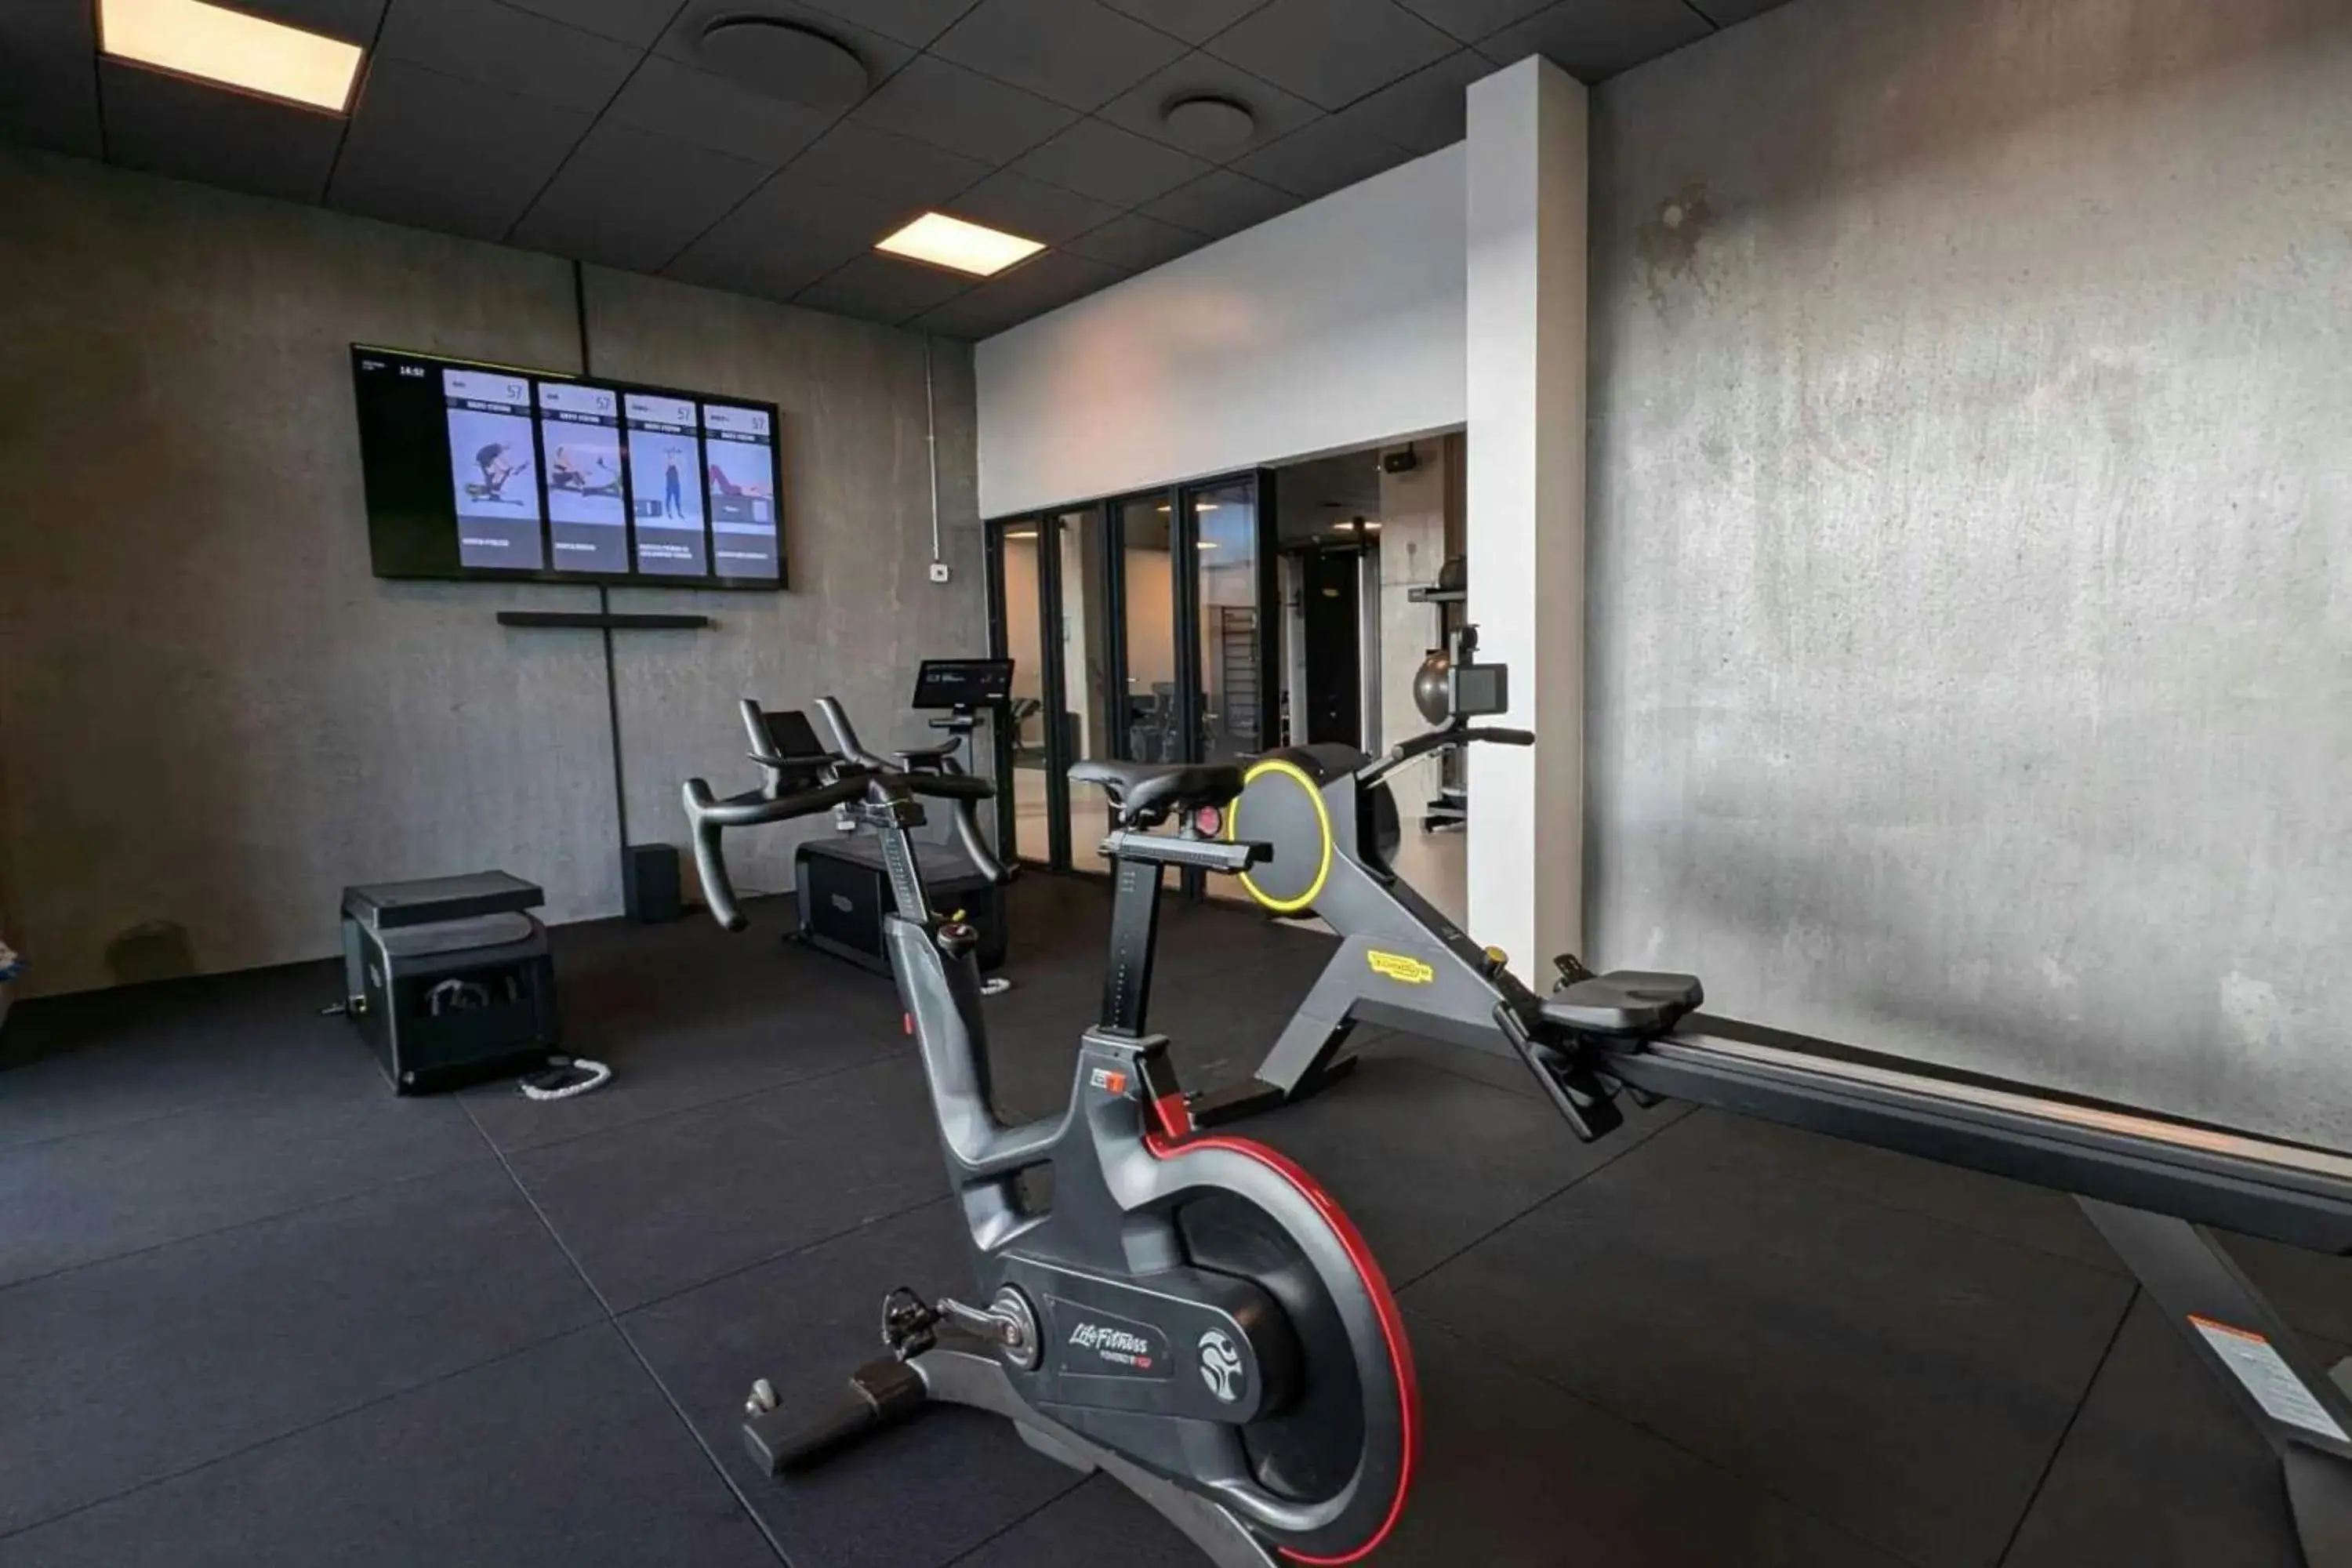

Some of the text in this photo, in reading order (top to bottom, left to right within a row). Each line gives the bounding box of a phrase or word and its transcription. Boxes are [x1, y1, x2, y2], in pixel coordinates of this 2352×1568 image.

[506, 383, 523, 401] 57
[596, 396, 611, 411] 57
[677, 406, 691, 422] 57
[752, 416, 764, 430] 57
[1069, 1323, 1148, 1353] Life Fitness
